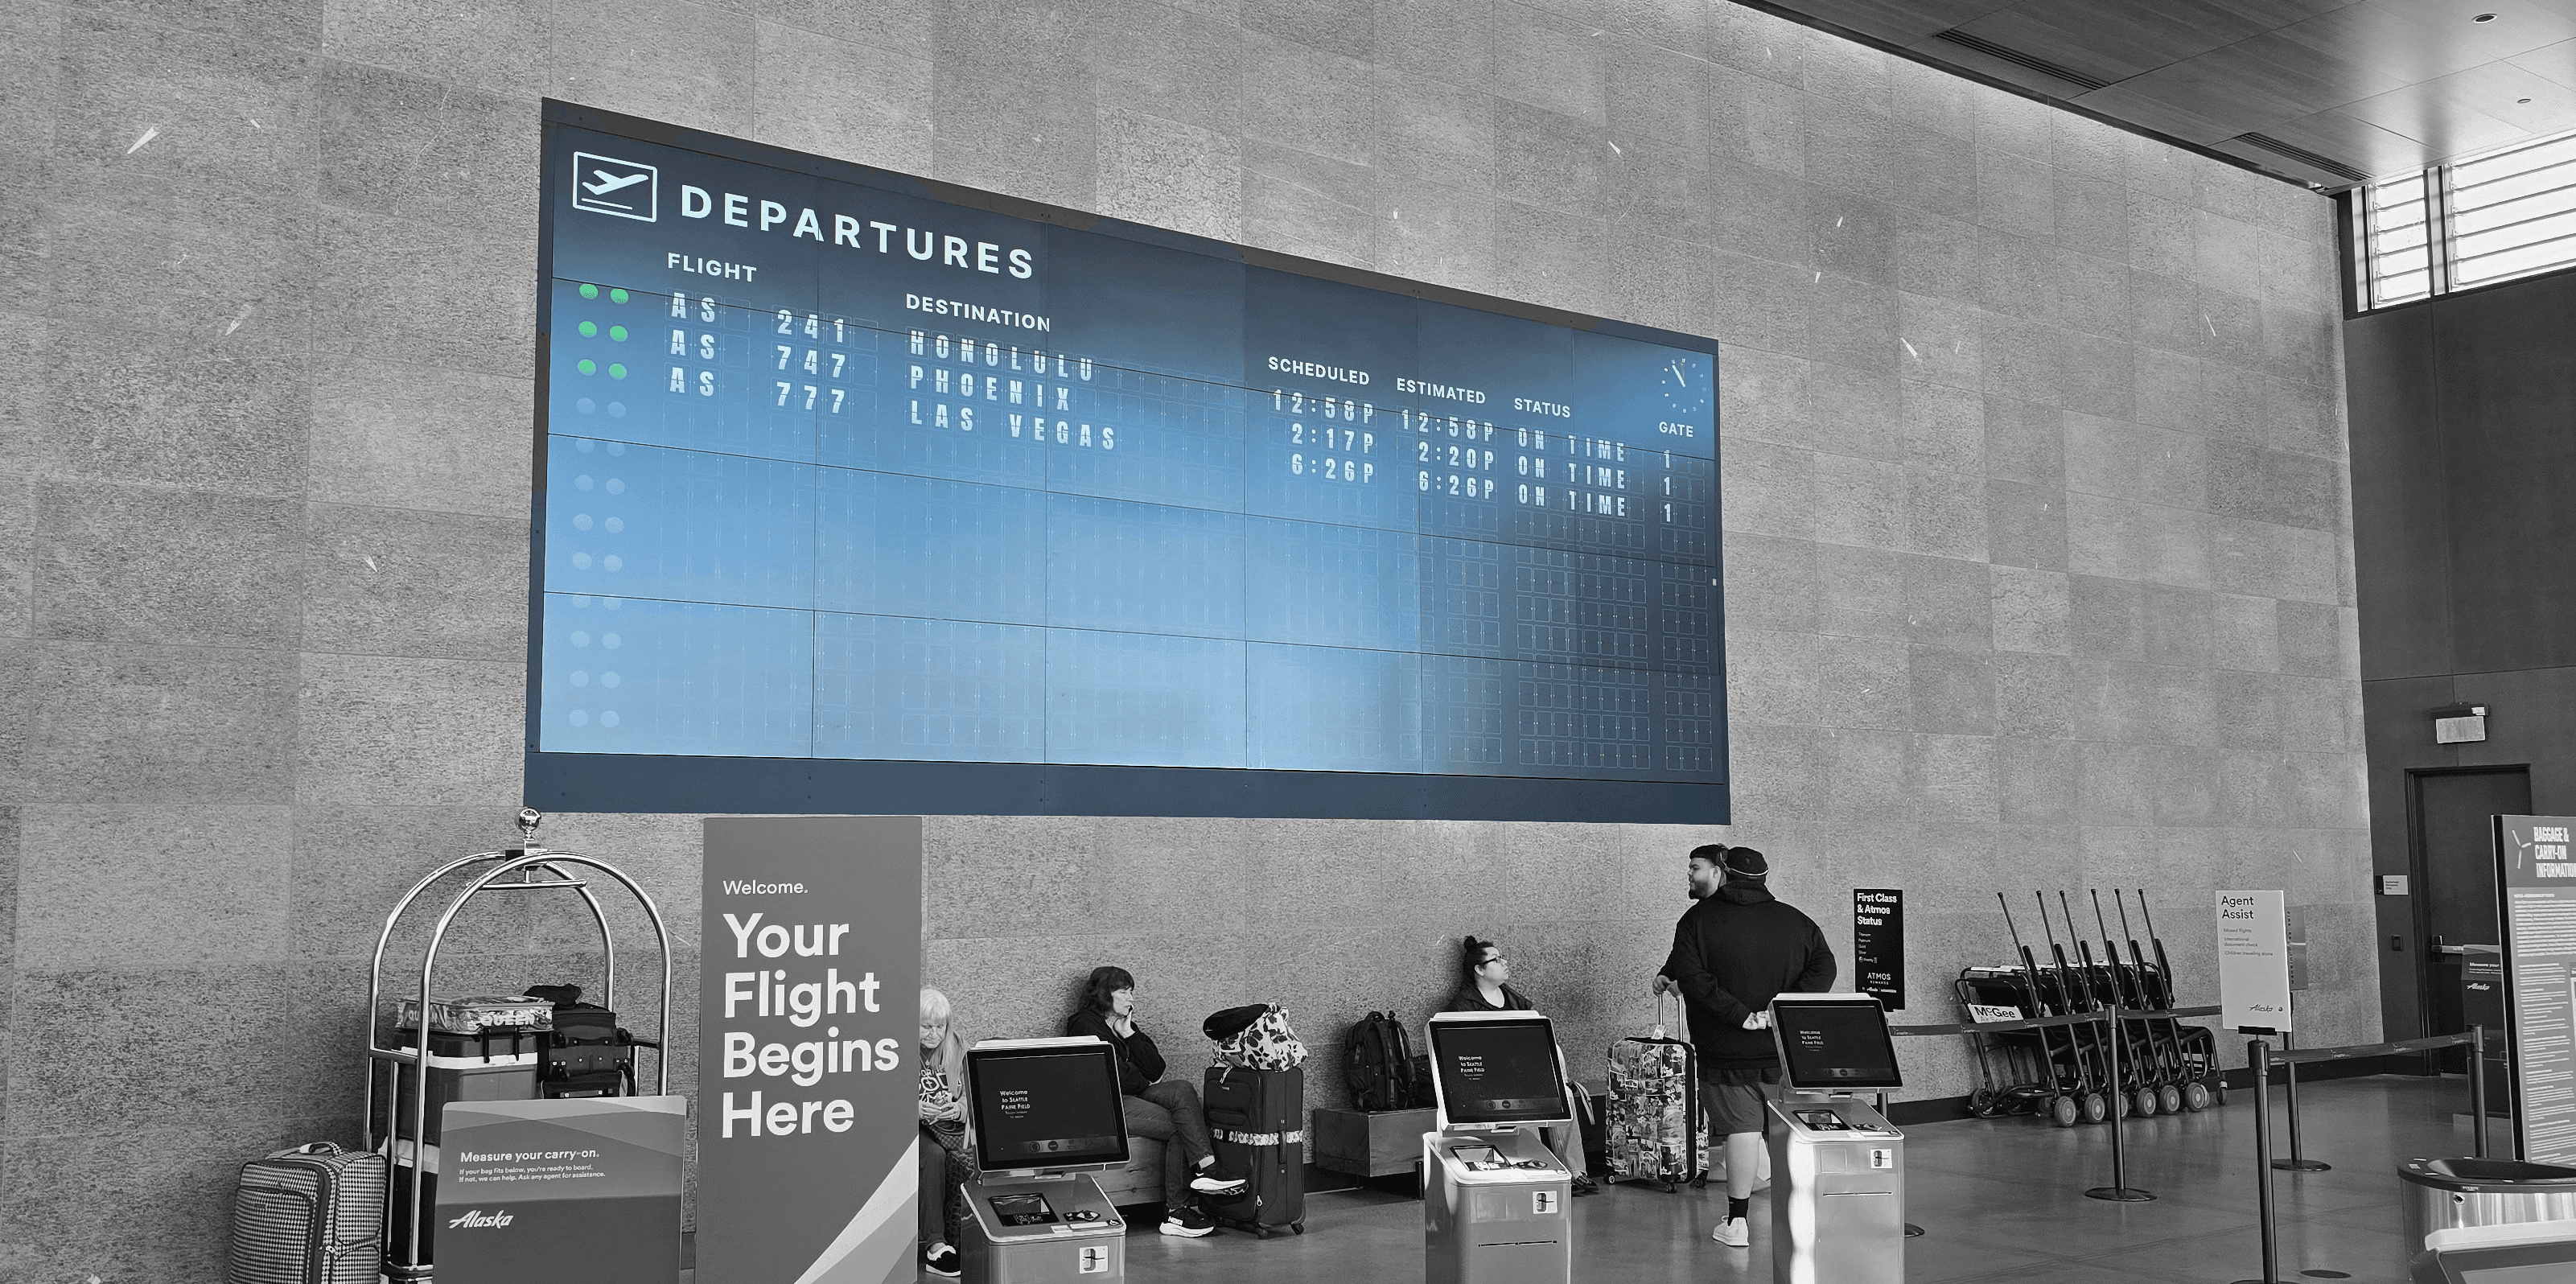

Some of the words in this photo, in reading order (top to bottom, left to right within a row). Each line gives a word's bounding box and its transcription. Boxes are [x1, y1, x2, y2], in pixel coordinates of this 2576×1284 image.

[681, 184, 1032, 279] DEPARTURES
[668, 253, 757, 282] FLIGHT
[671, 292, 715, 323] AS
[777, 309, 844, 343] 241
[906, 293, 1050, 332] DESTINATION
[670, 329, 715, 359] AS
[777, 345, 846, 377] 747
[911, 330, 1092, 381] HONOLULU
[1268, 356, 1369, 385] SCHEDULED
[669, 367, 714, 397] AS
[776, 381, 845, 414] 777
[911, 365, 1069, 411] PHOENIX
[1397, 377, 1486, 404] ESTIMATED
[1274, 389, 1373, 423] 12:58P
[1514, 397, 1570, 418] STATUS
[911, 400, 973, 431] LAS
[1009, 414, 1114, 450] VEGAS
[1292, 423, 1373, 453] 2:17P
[1401, 409, 1493, 442] 12:58P
[1659, 421, 1693, 438] GATE
[1418, 442, 1494, 471] 2:20P
[1519, 427, 1544, 450] ON
[1569, 434, 1624, 462] TIME
[1664, 450, 1670, 468] 1
[1292, 454, 1373, 483] 6:26P
[1519, 455, 1545, 478] ON
[1569, 463, 1625, 489] TIME
[1419, 471, 1494, 499] 6:26P
[1664, 476, 1670, 495] 1
[1519, 484, 1545, 506] ON
[1569, 490, 1625, 516] TIME
[1664, 503, 1671, 522] 1
[2533, 826, 2564, 842] BAGGAGE
[2563, 827, 2570, 842] &
[2534, 844, 2567, 860] CARRY-ON
[723, 879, 809, 895] Welcome.
[1857, 892, 1874, 902] First
[1875, 893, 1897, 903] Class
[2221, 895, 2254, 907] Agent
[1857, 904, 1864, 913] &
[1865, 905, 1891, 915] Atmos
[1857, 916, 1883, 925] Status
[2222, 909, 2254, 919] Assist
[722, 912, 850, 958] Your
[1867, 973, 1891, 981] ATMOS
[724, 968, 880, 1027] Flight
[1974, 1006, 2016, 1018] McGee
[723, 1026, 899, 1087] Begins
[722, 1090, 854, 1138] Here
[460, 1151, 512, 1163] Measure
[515, 1151, 542, 1163] your
[449, 1209, 514, 1229] Alaska
